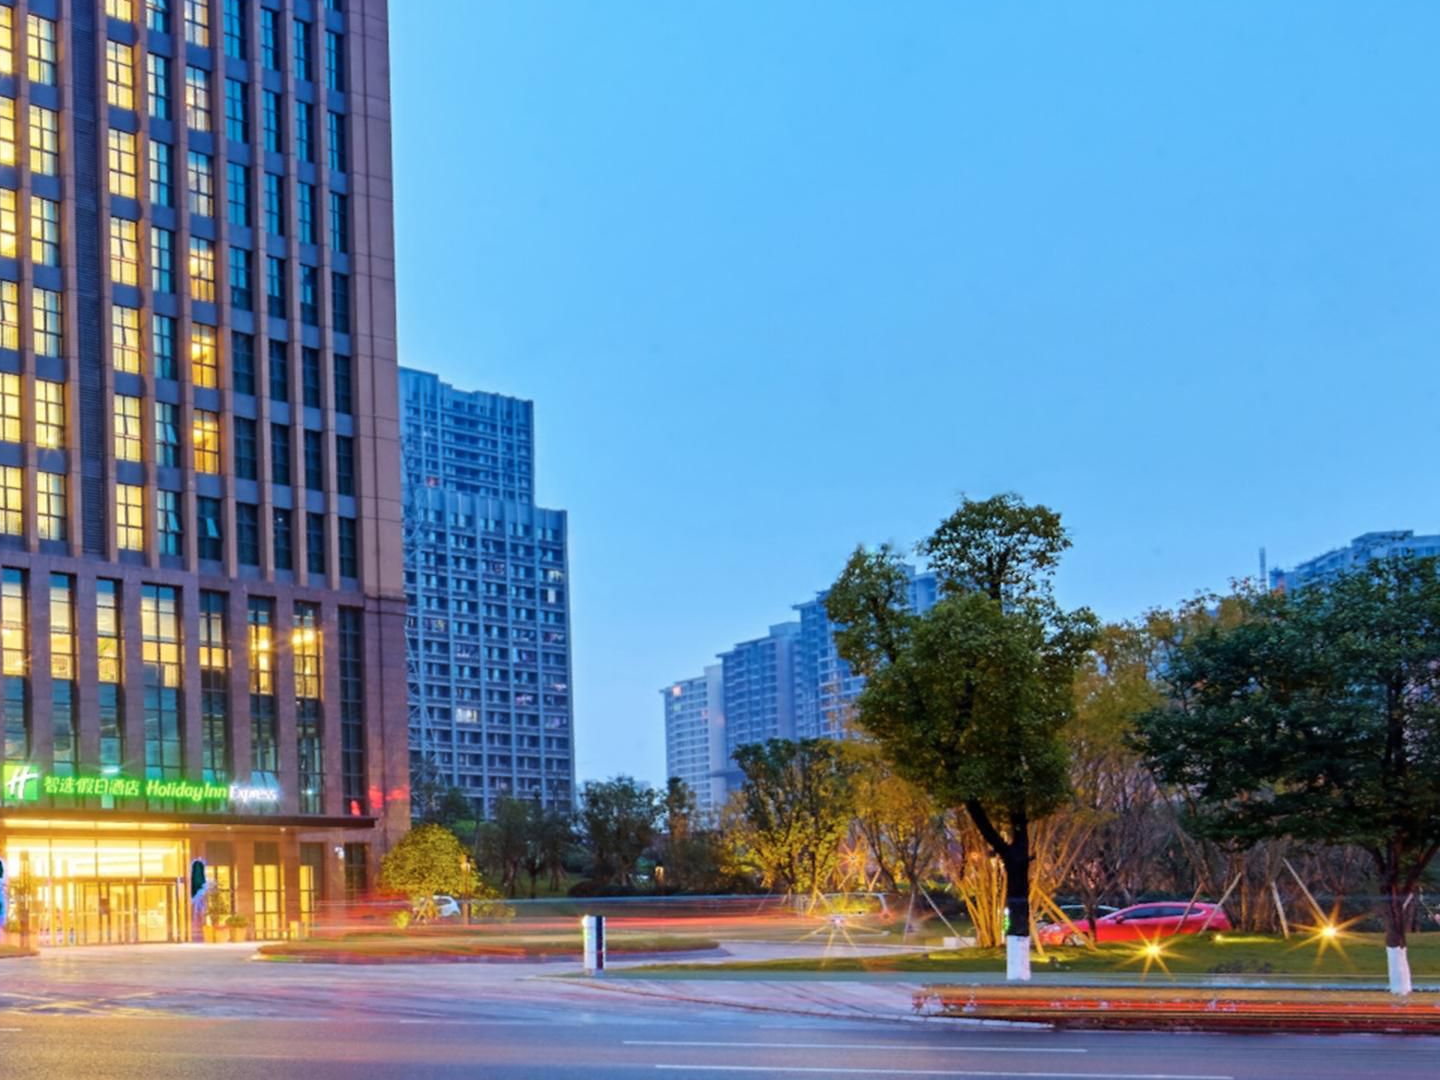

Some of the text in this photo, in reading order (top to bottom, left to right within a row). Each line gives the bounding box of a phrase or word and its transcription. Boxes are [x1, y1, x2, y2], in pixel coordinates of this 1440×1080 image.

[44, 775, 140, 796] 智选假日酒店
[146, 779, 277, 801] Holiday Inn Express
